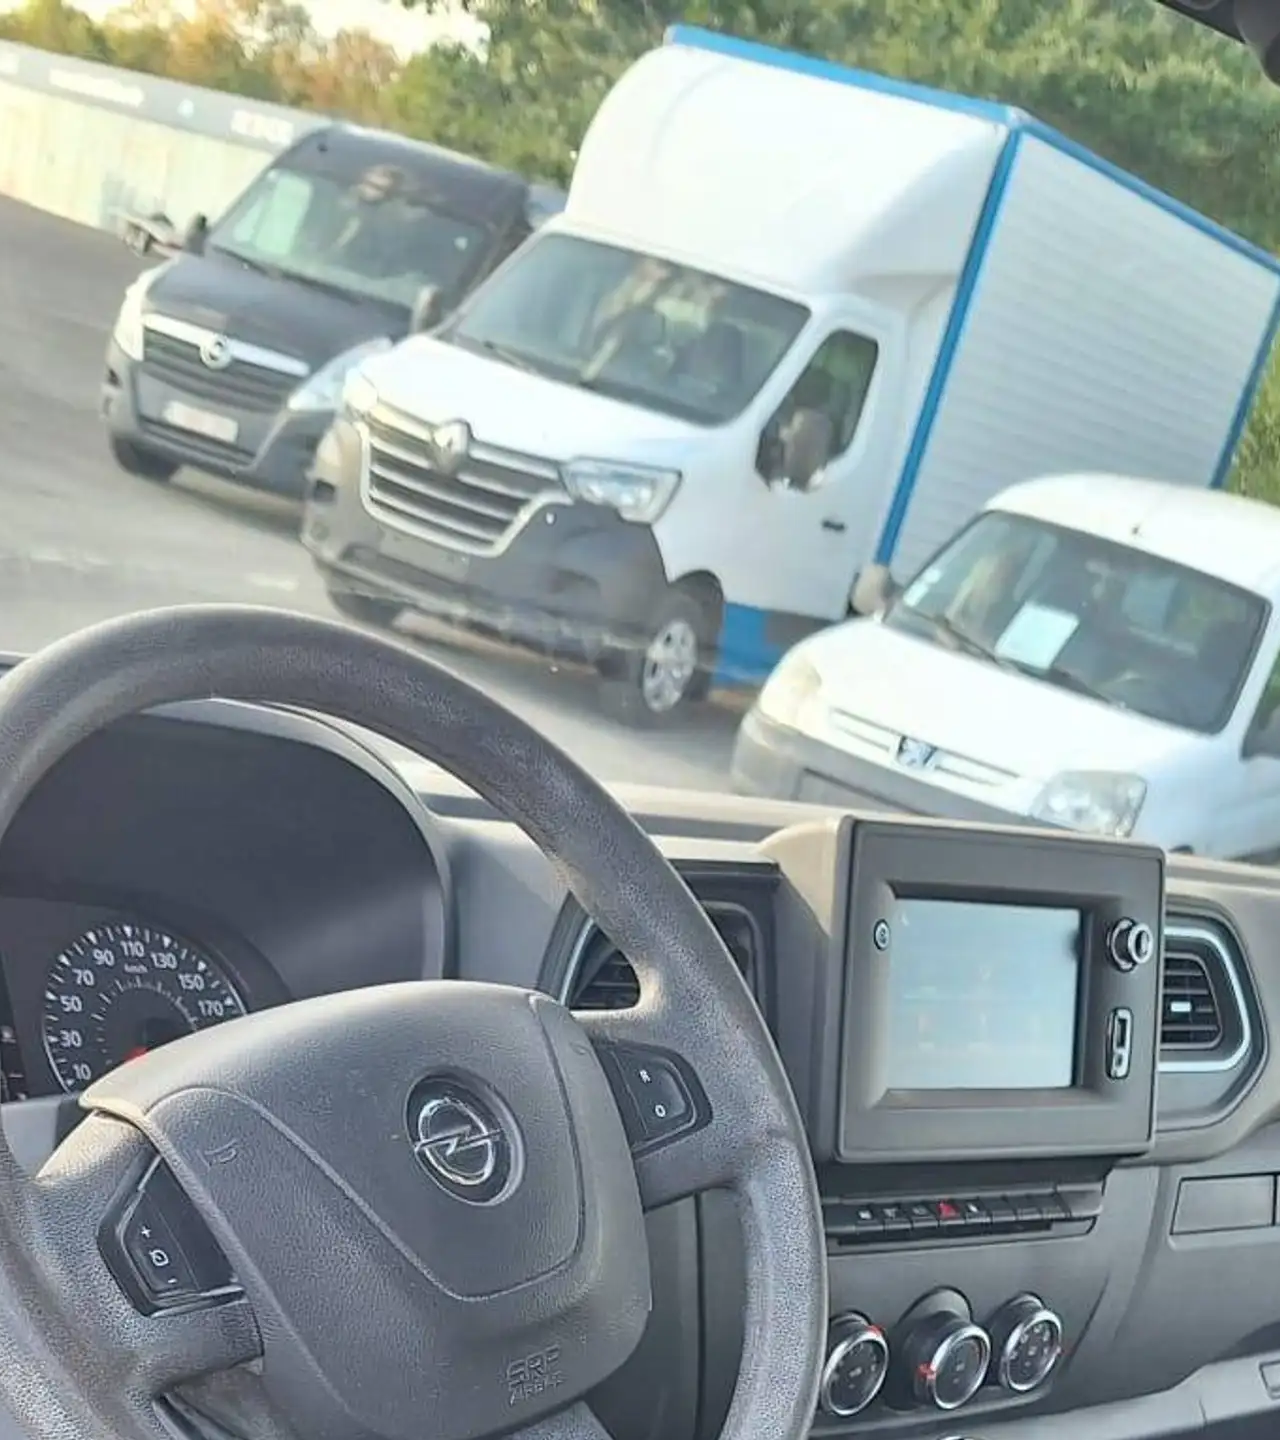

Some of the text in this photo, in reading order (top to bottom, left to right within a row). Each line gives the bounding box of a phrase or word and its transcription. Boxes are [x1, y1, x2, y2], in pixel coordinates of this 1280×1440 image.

[120, 941, 145, 957] 110
[93, 949, 114, 966] 90
[150, 953, 177, 969] 130
[72, 968, 94, 986] 70
[178, 973, 204, 990] 150
[60, 996, 82, 1012] 50
[198, 1000, 223, 1016] 170
[60, 1031, 82, 1047] 30
[72, 1063, 91, 1081] 10
